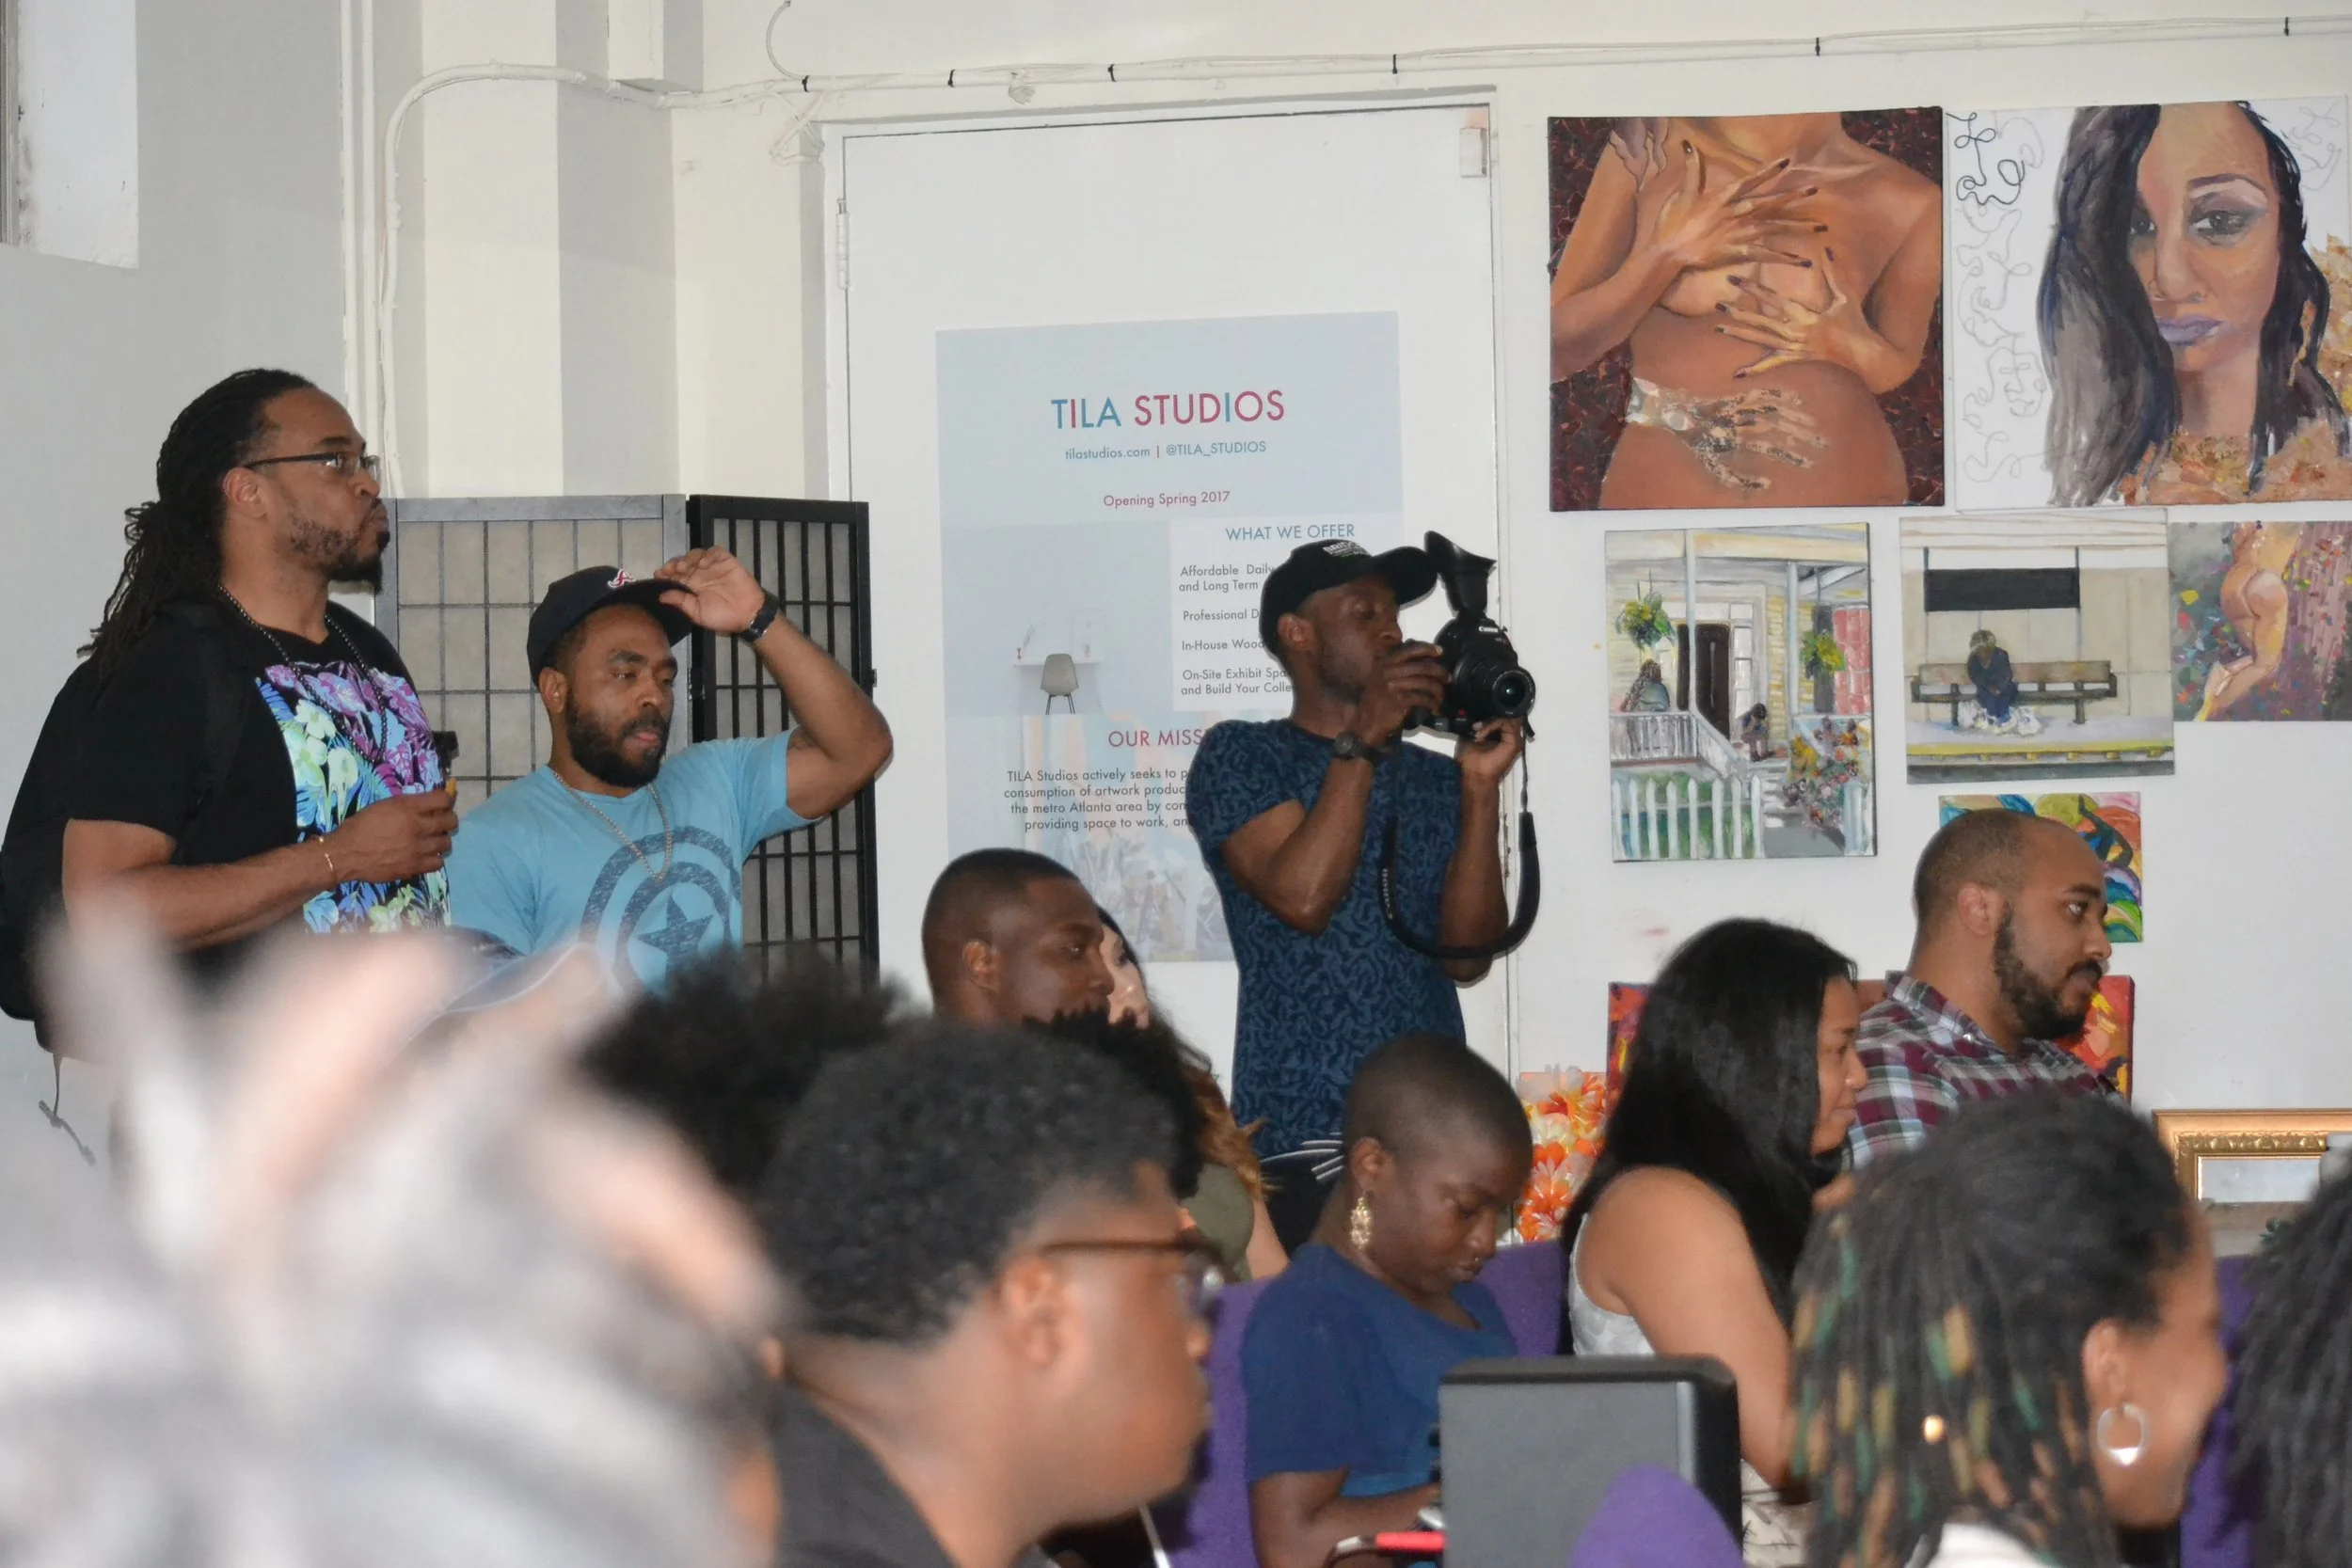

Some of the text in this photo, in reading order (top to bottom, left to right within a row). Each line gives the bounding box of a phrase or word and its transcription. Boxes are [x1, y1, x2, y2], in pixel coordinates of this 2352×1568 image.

[1051, 389, 1285, 429] TILA STUDIOS
[1065, 446, 1151, 460] tilastudios.com
[1166, 441, 1267, 457] @TILA_STUDIOS
[1103, 490, 1231, 509] Opening Spring 2017
[1225, 523, 1356, 541] WHAT WE OFFER
[1180, 563, 1239, 577] Affordable
[1179, 578, 1259, 594] and Long Term
[1183, 608, 1248, 622] Professional
[1182, 640, 1228, 651] In-House
[1182, 667, 1287, 681] On-Site Exhibit Spa
[1181, 680, 1293, 695] and Build Your Colle
[1108, 728, 1203, 748] OUR MISS
[1008, 770, 1033, 782] TILA
[1037, 768, 1078, 782] Studios
[1082, 768, 1126, 783] actively
[1130, 767, 1161, 780] seeks
[1165, 768, 1177, 779] to
[1004, 782, 1185, 800] consumption of artwork produc
[1010, 802, 1028, 815] the
[1033, 802, 1066, 814] metro
[1069, 801, 1112, 813] Atlanta
[1116, 802, 1142, 812] area
[1147, 800, 1161, 815] by
[1025, 815, 1188, 833] providing space to work, an
